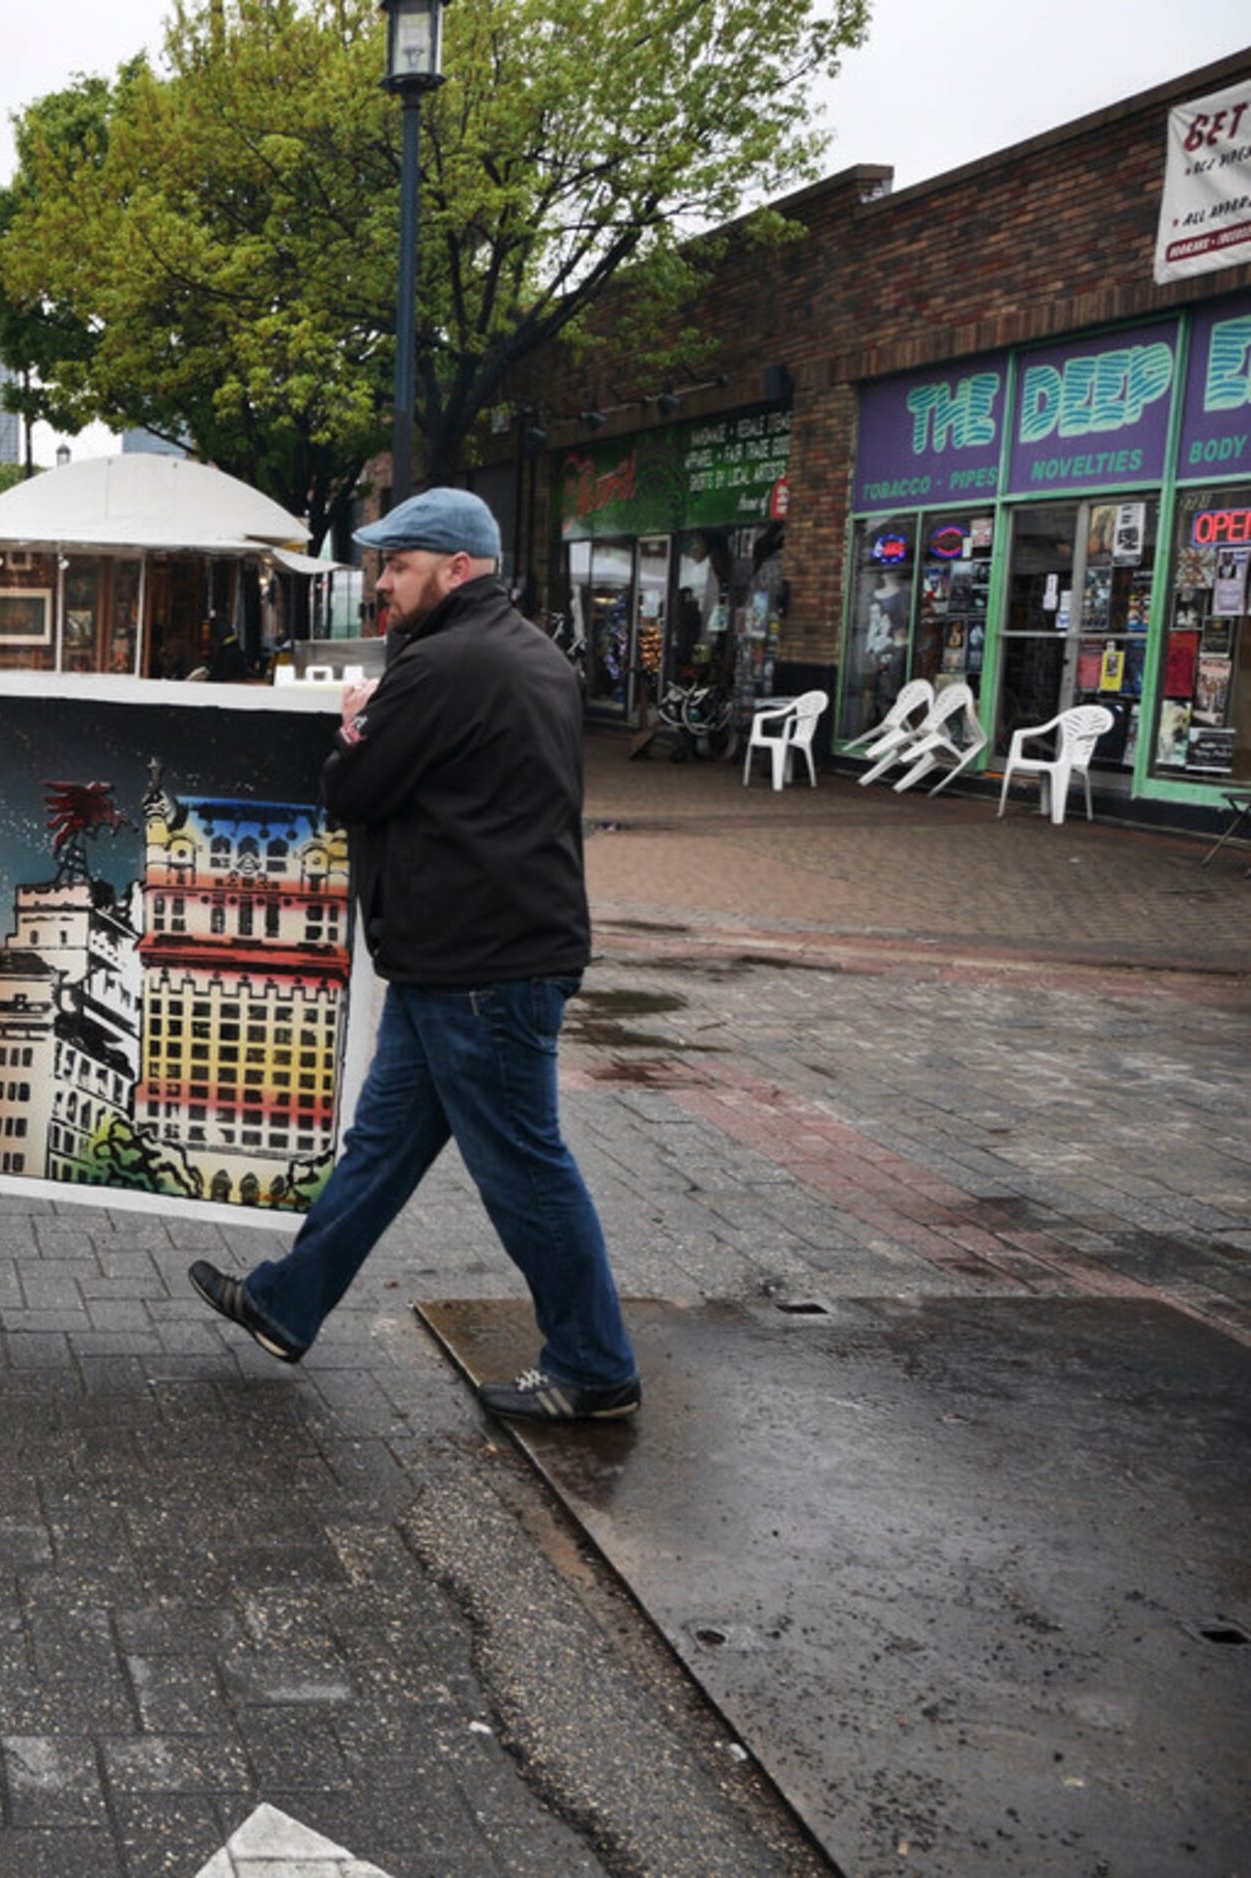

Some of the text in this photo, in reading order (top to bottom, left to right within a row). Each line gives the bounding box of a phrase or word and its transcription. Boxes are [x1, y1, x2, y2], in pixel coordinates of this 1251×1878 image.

[1184, 103, 1248, 151] GET
[907, 342, 1174, 454] THE DEEP
[1031, 449, 1143, 482] NOVELTIES
[1189, 433, 1248, 464] BODY
[862, 465, 999, 501] TOBACCO PIPES
